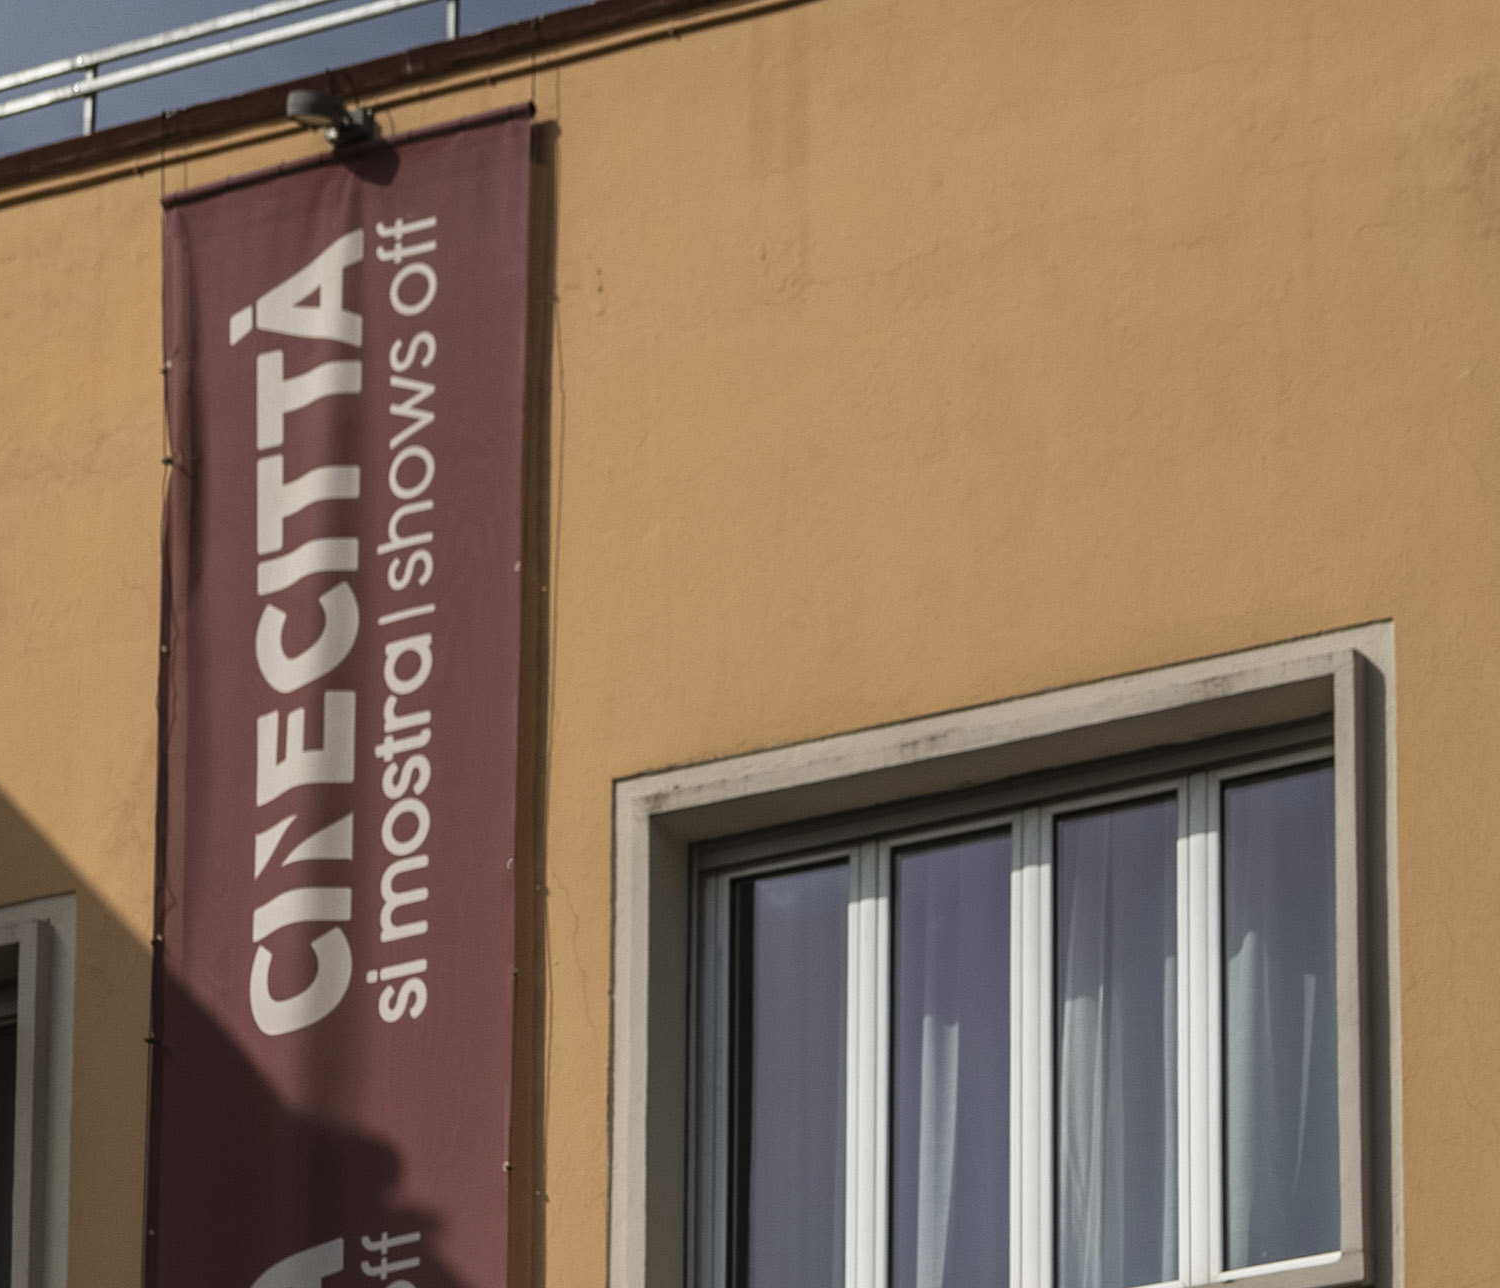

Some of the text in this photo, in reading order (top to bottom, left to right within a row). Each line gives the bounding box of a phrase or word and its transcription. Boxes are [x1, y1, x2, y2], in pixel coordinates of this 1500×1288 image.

[375, 216, 438, 316] off
[376, 331, 437, 591] shows
[228, 230, 364, 1038] CINECITTÀ
[374, 633, 433, 943] mostra
[366, 958, 428, 1023] si
